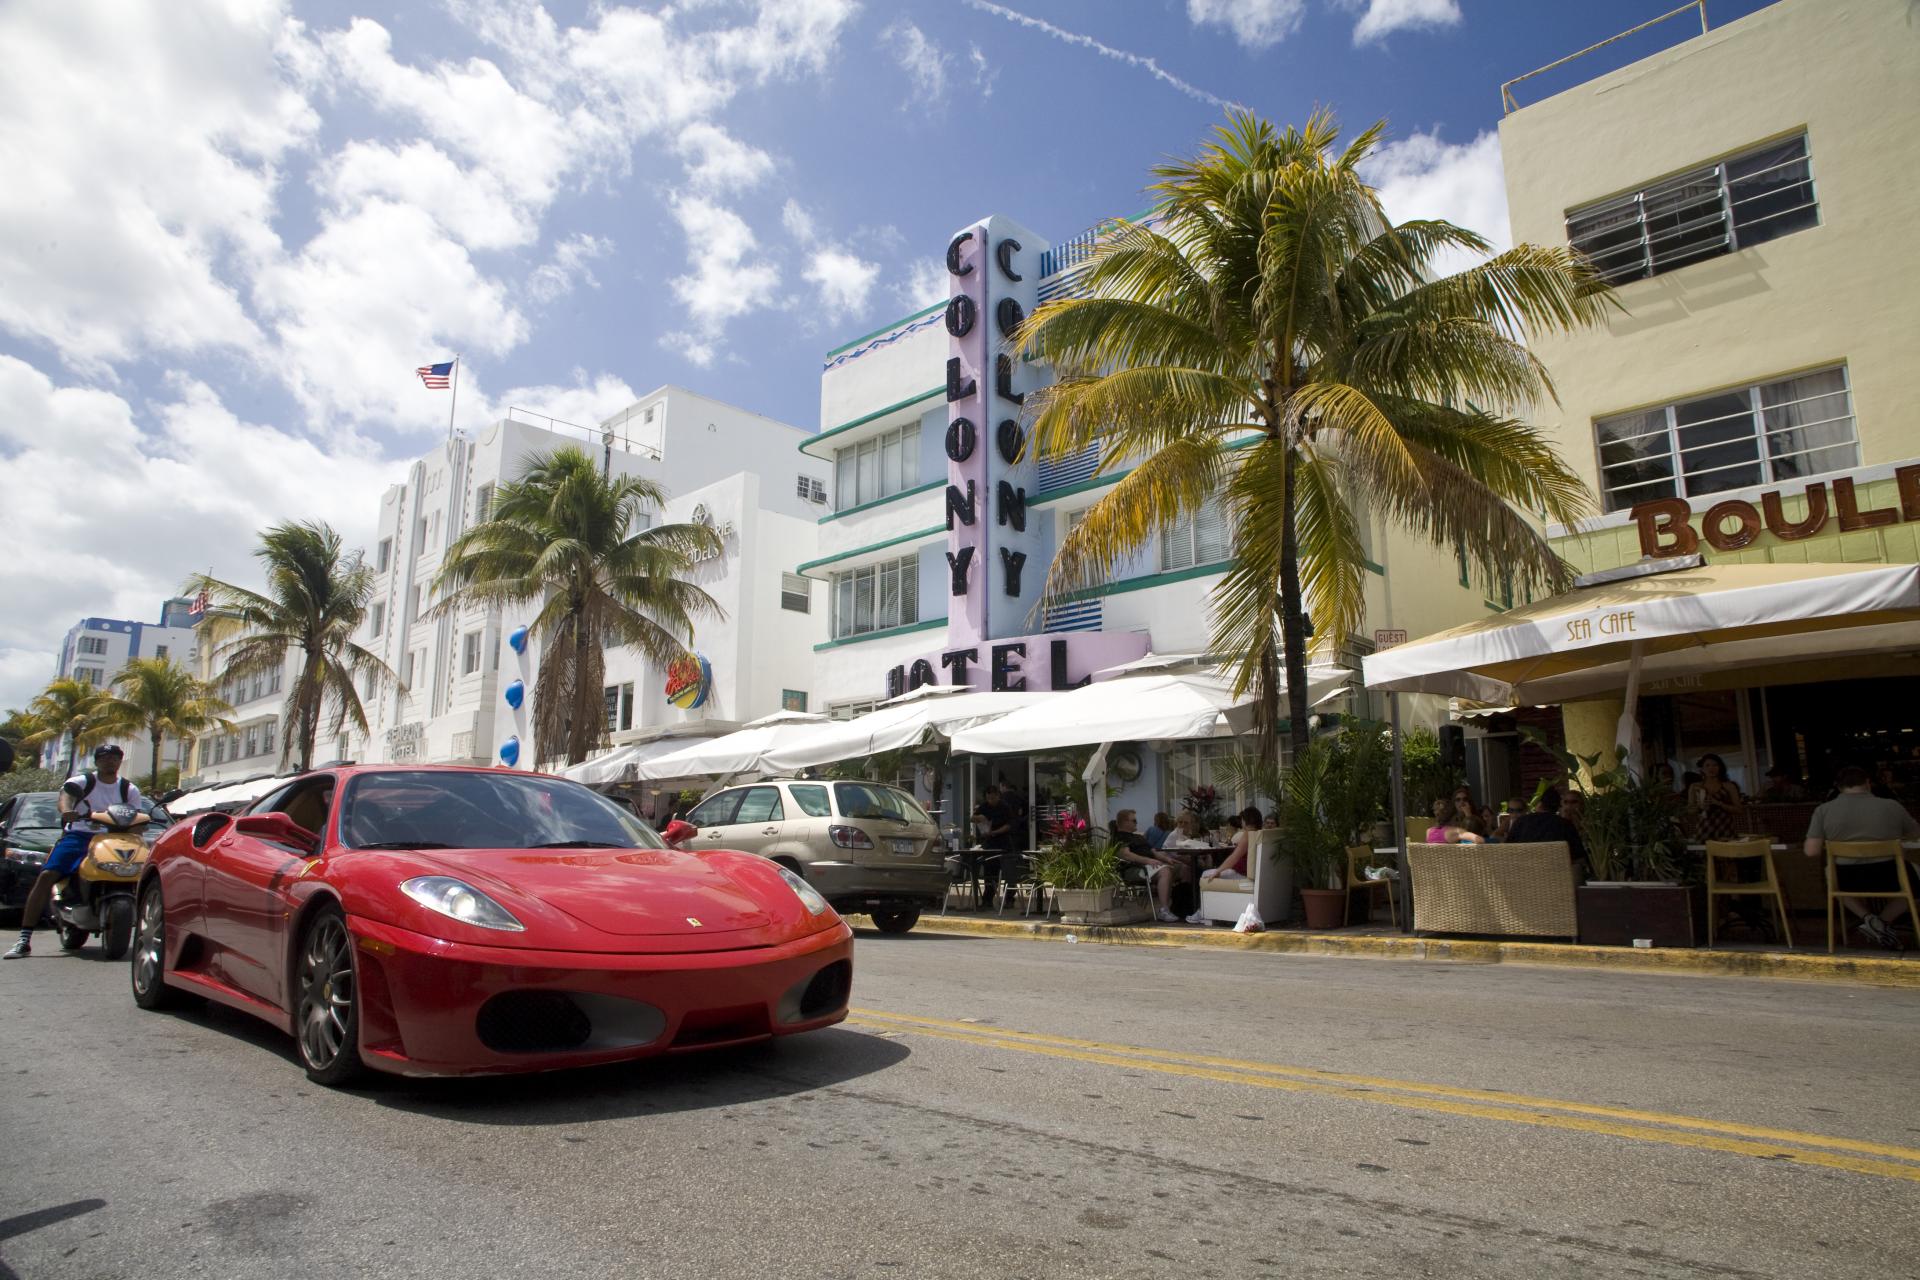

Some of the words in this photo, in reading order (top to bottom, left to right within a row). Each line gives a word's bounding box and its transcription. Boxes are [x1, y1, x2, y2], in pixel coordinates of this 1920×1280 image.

[945, 232, 977, 596] COLONY
[997, 238, 1027, 597] COLONY
[1378, 633, 1404, 643] GUEST
[1567, 618, 1591, 642] SEA
[1600, 610, 1637, 635] CAFE
[886, 640, 1092, 698] HOTEL
